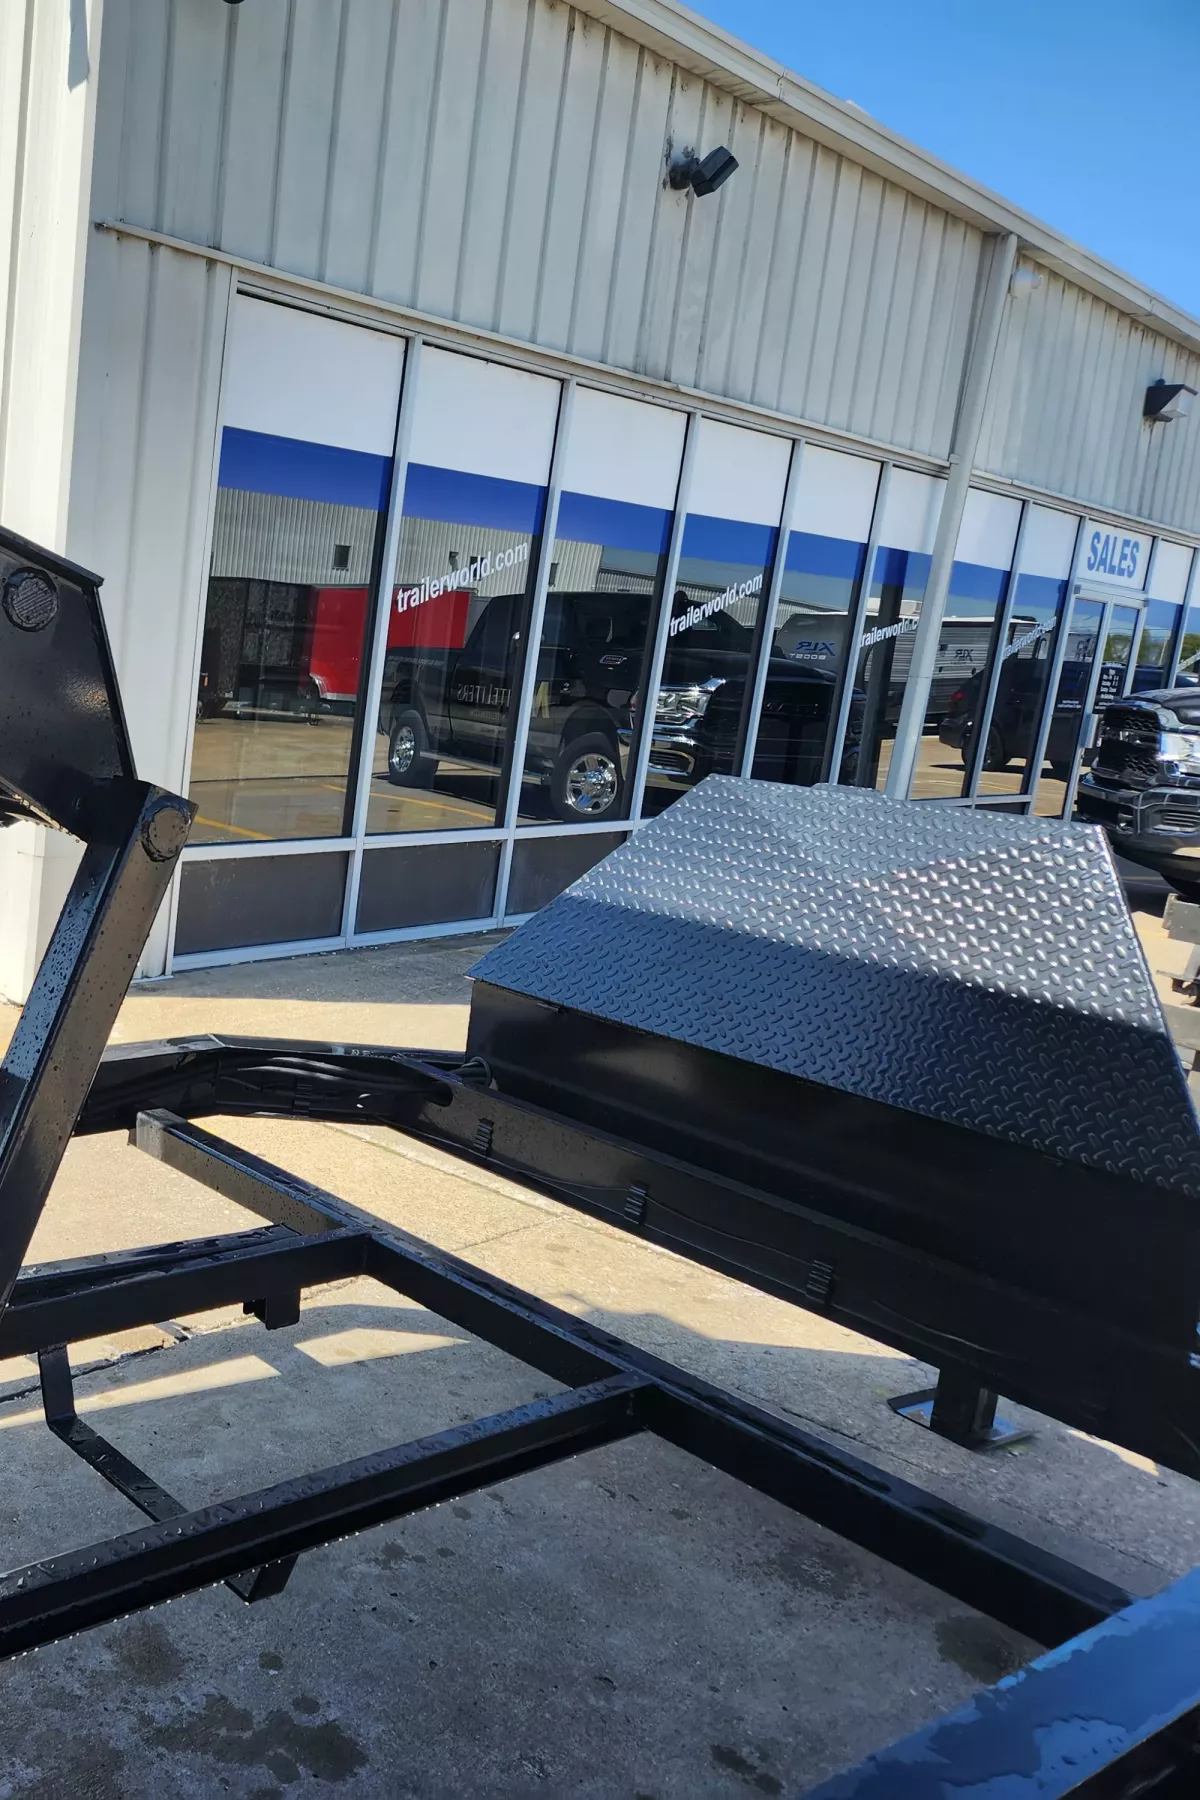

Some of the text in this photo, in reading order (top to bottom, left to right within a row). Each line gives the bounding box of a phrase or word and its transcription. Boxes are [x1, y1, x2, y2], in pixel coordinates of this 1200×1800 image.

[396, 541, 529, 614] trailerworld.com
[1086, 530, 1140, 579] SALES
[669, 573, 763, 637] trailerworld.com
